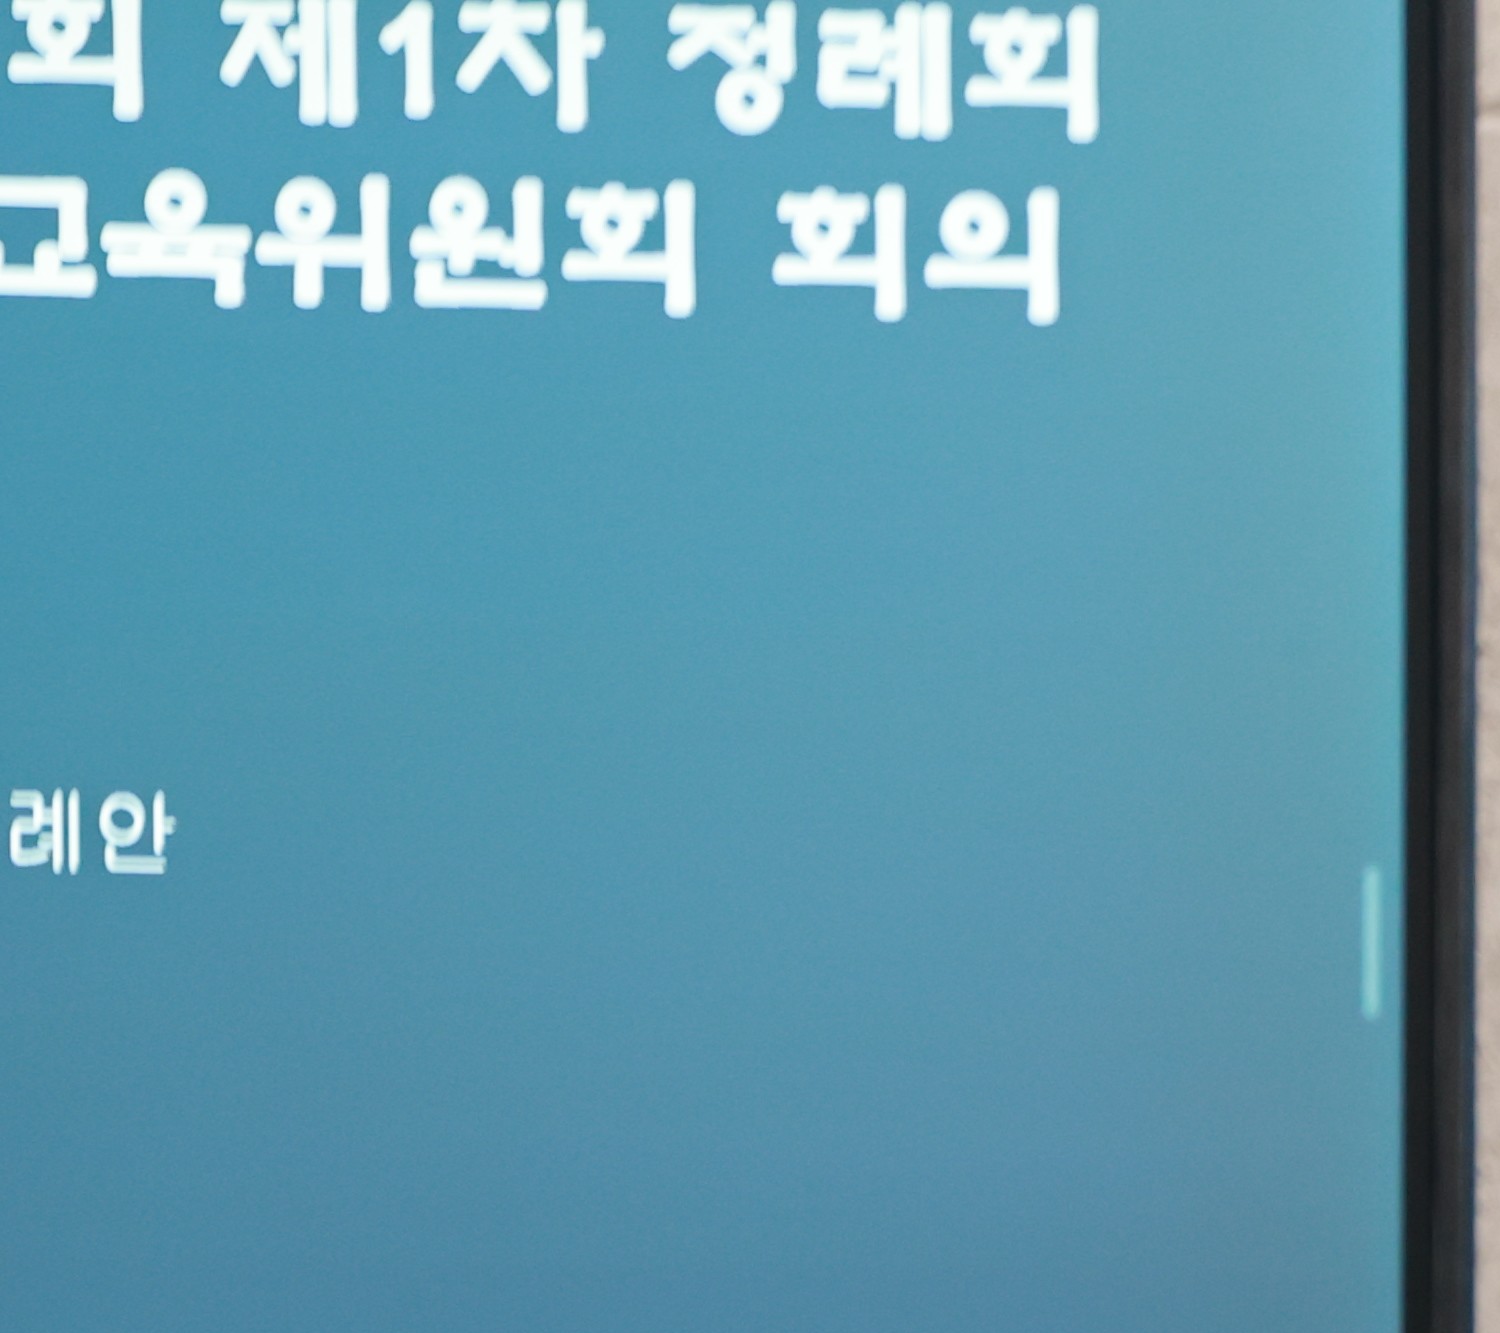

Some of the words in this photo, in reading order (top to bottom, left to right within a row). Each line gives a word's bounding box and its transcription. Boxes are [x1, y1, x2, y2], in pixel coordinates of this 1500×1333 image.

[8, 0, 143, 121] 회
[220, 0, 605, 132] 제1차
[667, 0, 1098, 143] 정례회
[0, 167, 696, 318] 교육위원회
[772, 182, 1060, 326] 회의
[9, 787, 177, 875] 례안
